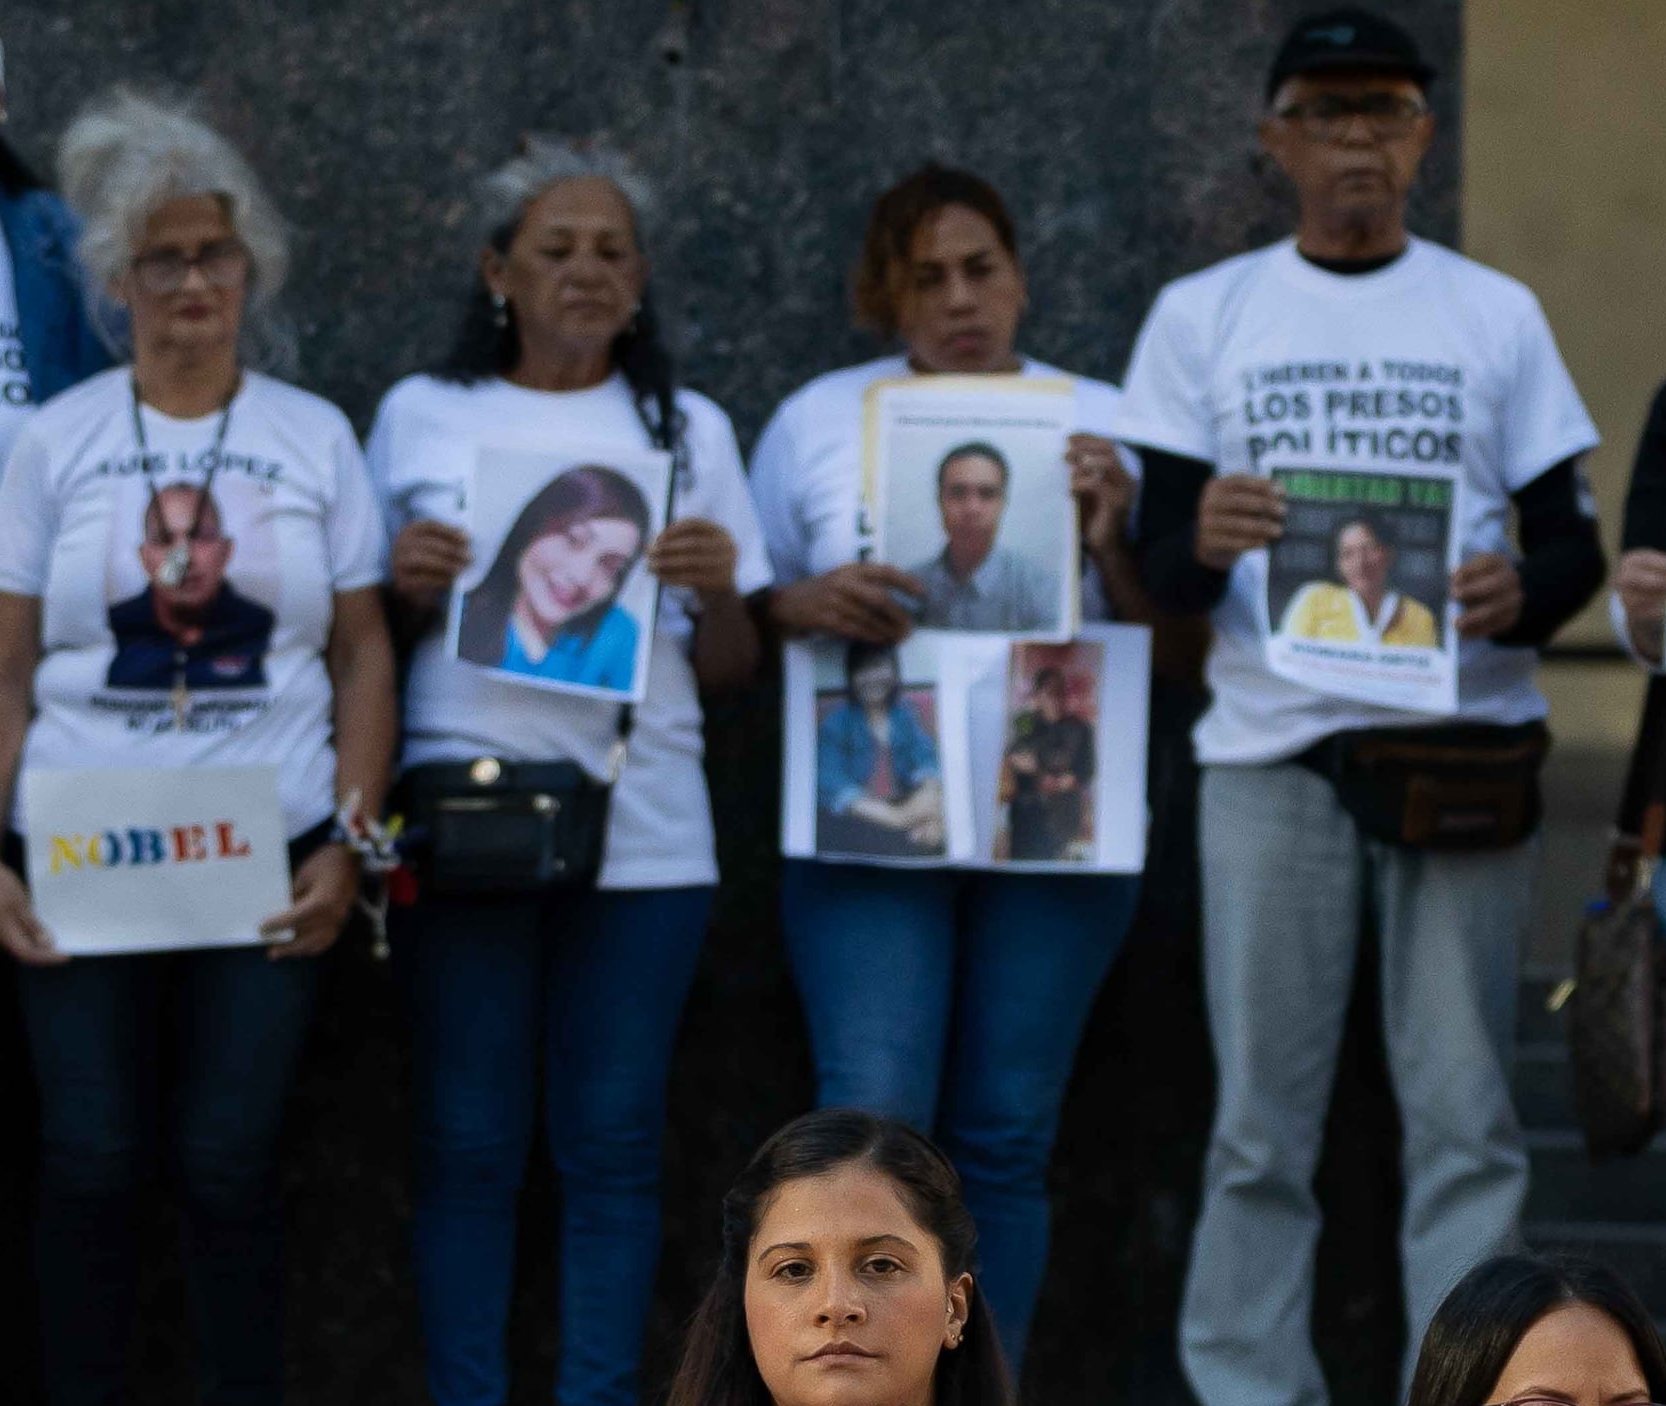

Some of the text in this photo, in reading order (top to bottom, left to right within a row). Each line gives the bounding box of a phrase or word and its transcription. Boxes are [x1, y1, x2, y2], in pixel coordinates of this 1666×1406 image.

[1246, 387, 1463, 426] LOS PRESOS
[49, 820, 252, 874] NOBEL
